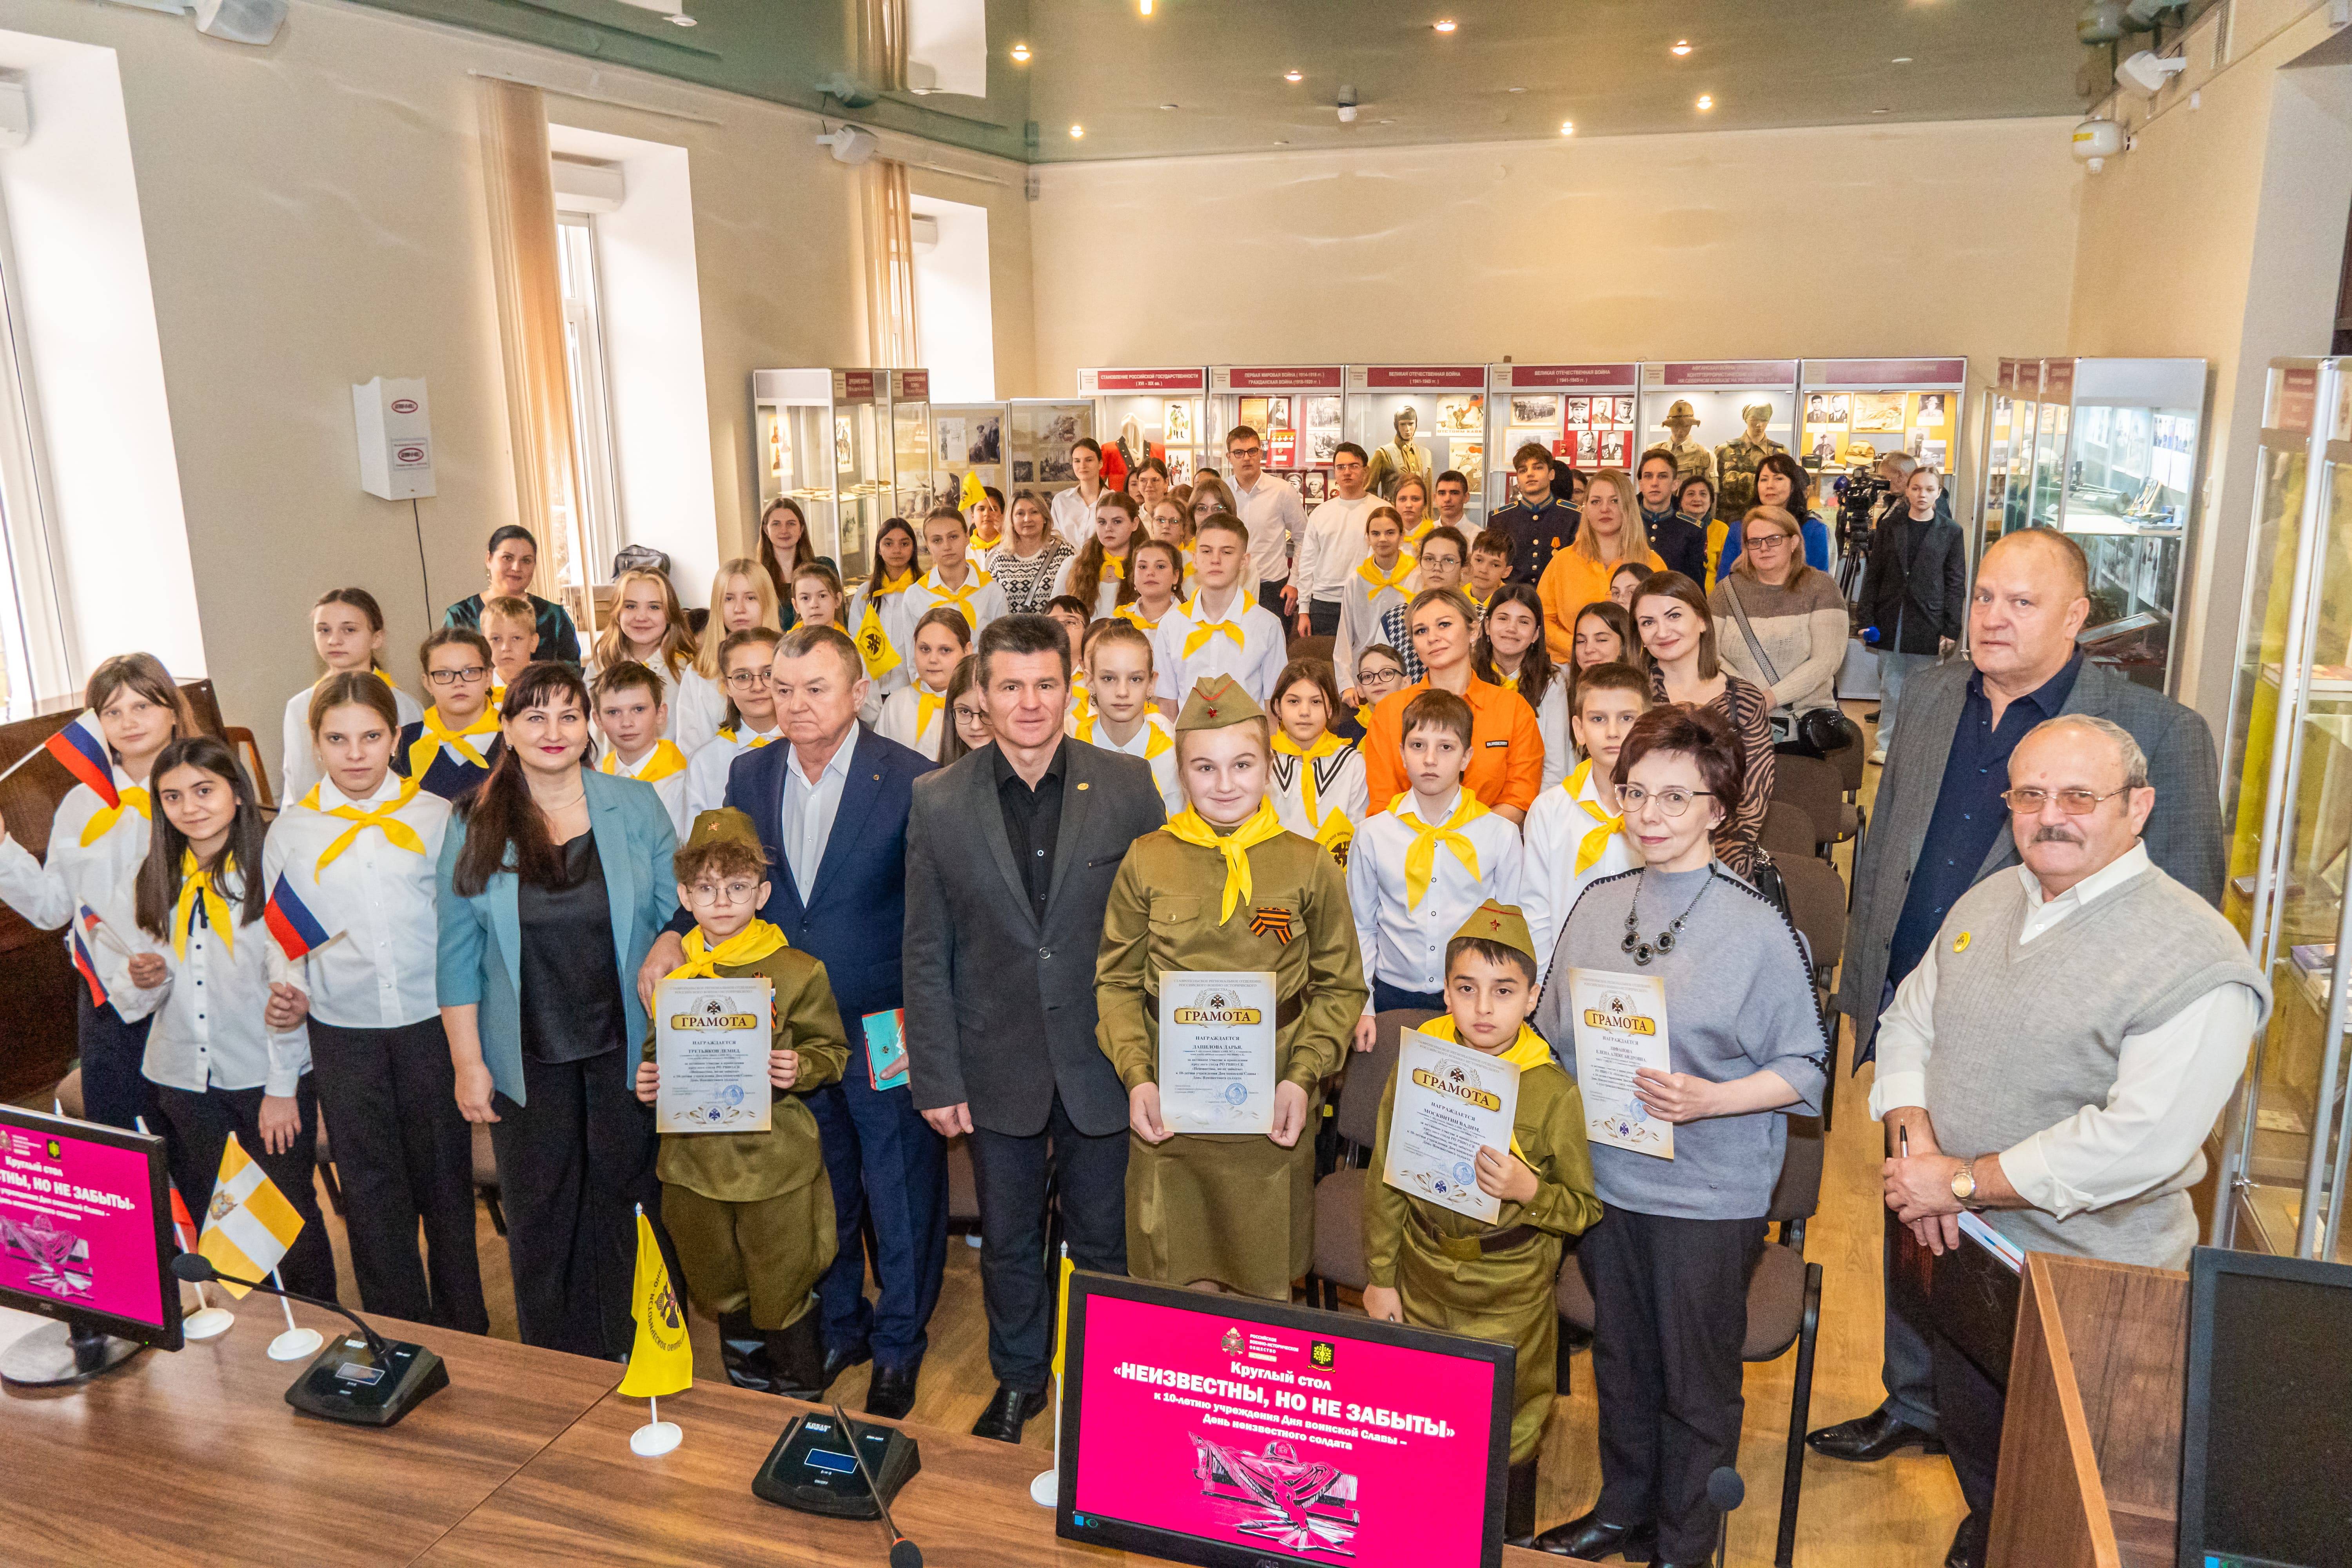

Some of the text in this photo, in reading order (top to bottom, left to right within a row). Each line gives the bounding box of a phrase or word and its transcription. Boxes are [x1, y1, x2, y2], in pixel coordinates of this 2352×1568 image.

[682, 1017, 747, 1027] ГРАМОТА
[1185, 1011, 1251, 1021] ГРАМОТА
[1592, 1013, 1647, 1031] ГРАМОТА
[1602, 1036, 1639, 1045] НАГРАЖДАЕТСЯ
[1423, 1073, 1490, 1106] ГРАМОТА
[1423, 1108, 1458, 1124] МОСКВИТИН
[1431, 1102, 1475, 1121] НАГРАЖДАЕТСЯ
[5, 1155, 64, 1177] Круглый стол
[33, 1176, 52, 1193] НО
[53, 1181, 72, 1197] НЕ
[73, 1185, 135, 1210] ЗАБЫТЫ»
[1249, 1339, 1299, 1352] ВОЕННО-ИСТОРИЧЕСКОЕ
[1250, 1334, 1277, 1342] РОССИЙСКОЕ
[1249, 1345, 1276, 1354] ОБЩЕСТВО
[1230, 1361, 1332, 1390] Круглый стол
[1113, 1361, 1455, 1438] «НЕИЗВЕСТНЫ, НО НЕ ЗАБЫТЫ»
[1154, 1392, 1161, 1401] к
[1163, 1392, 1212, 1409] 10-летию
[1213, 1403, 1280, 1423] учреждения
[1281, 1414, 1303, 1427] Дня
[1305, 1420, 1359, 1438] воинской
[1361, 1429, 1397, 1445] Славы
[1202, 1413, 1353, 1451] День неизвестного солдата
